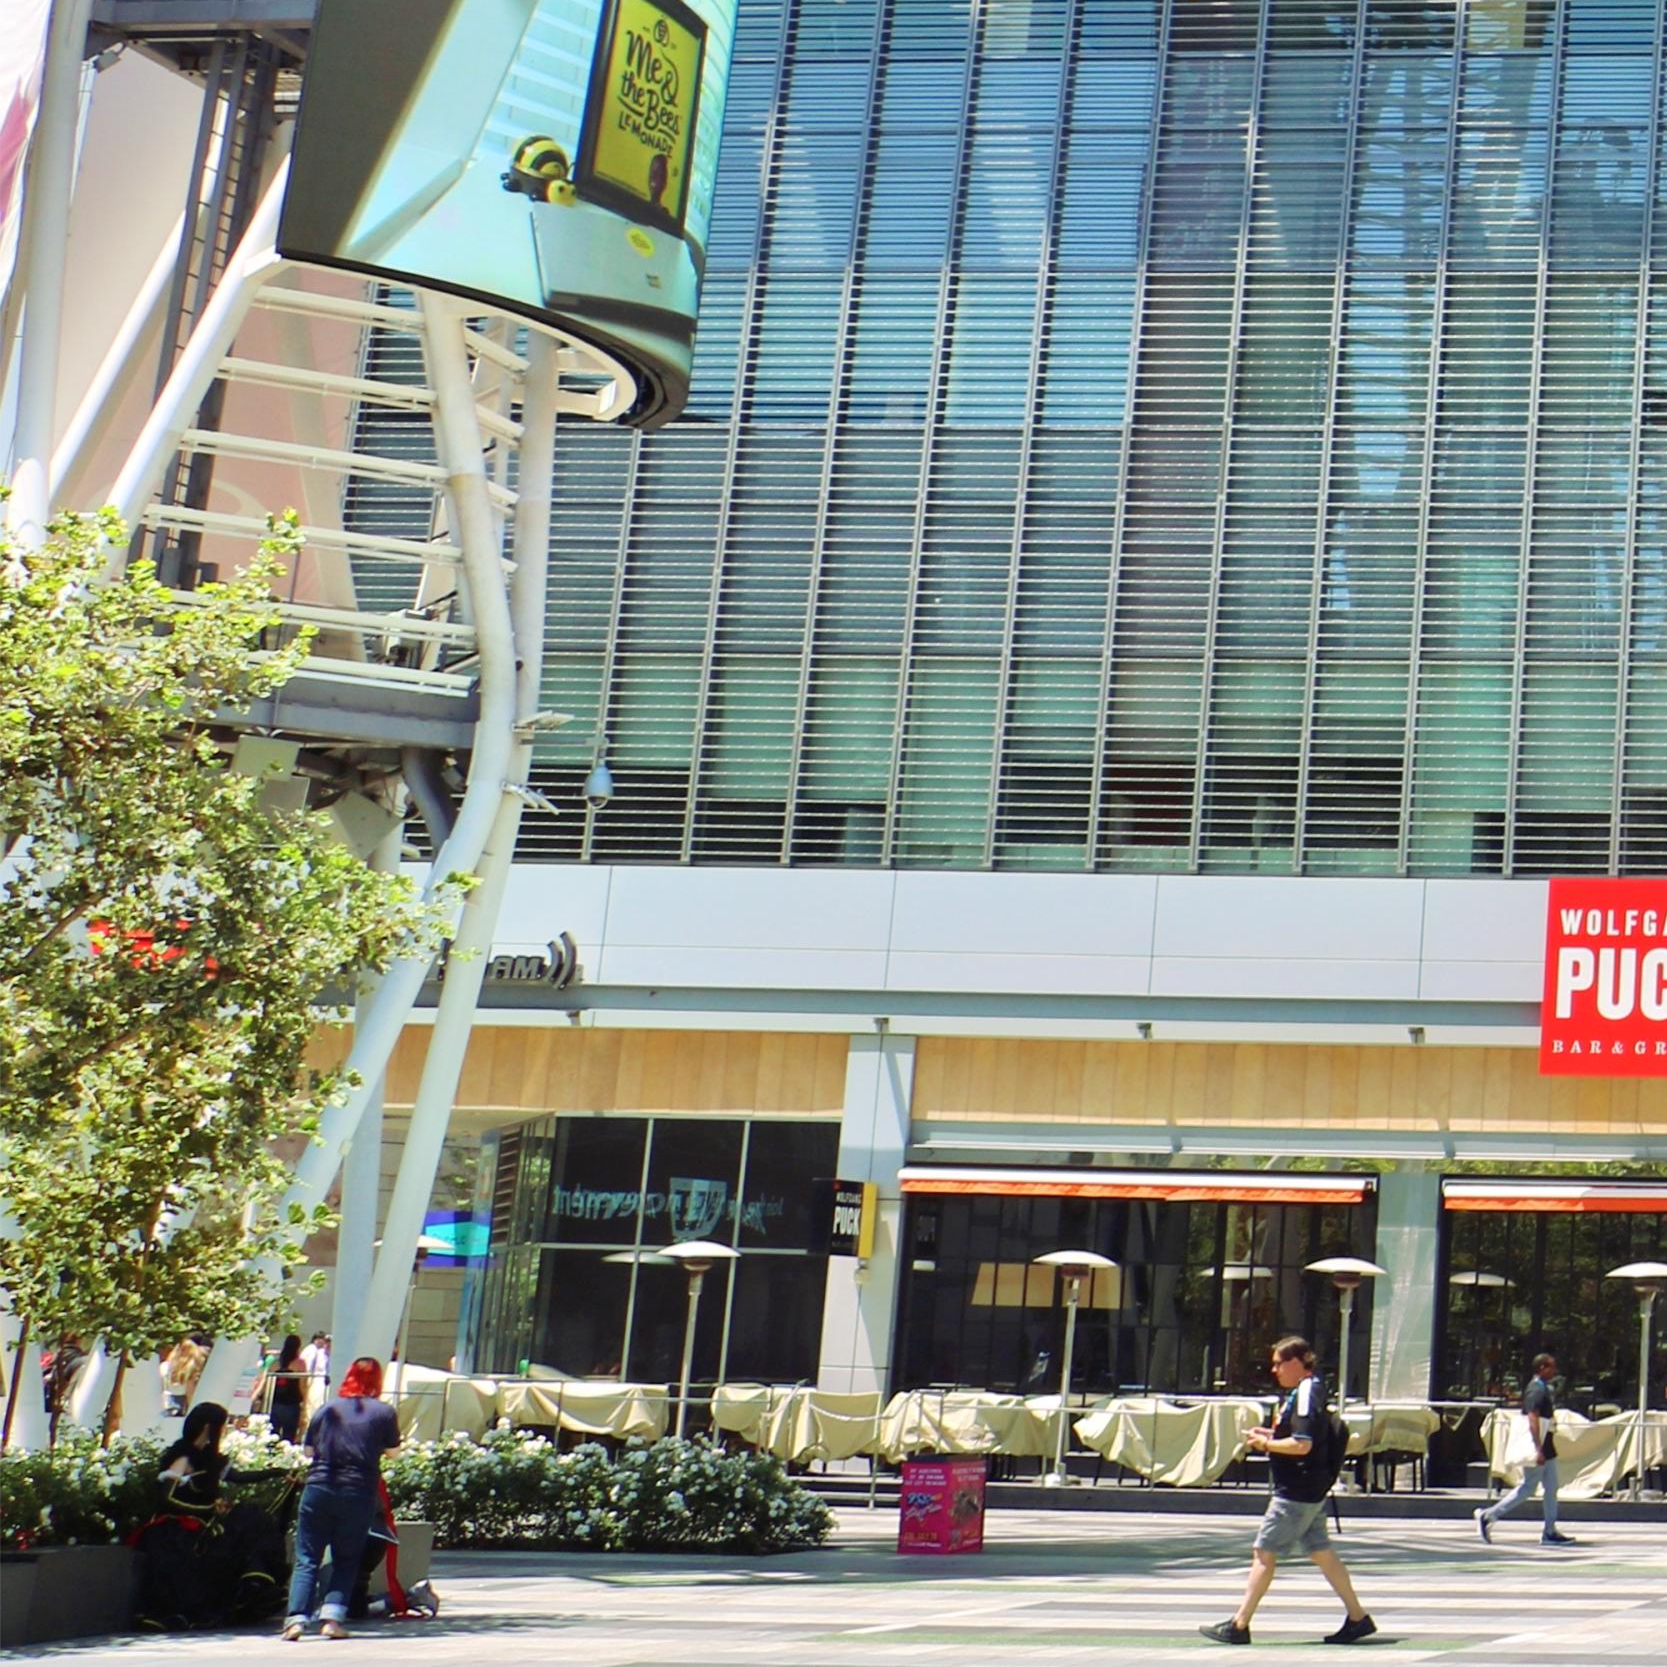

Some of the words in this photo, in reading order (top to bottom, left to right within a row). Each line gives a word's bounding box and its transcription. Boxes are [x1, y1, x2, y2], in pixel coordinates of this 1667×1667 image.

[626, 29, 664, 85] Me
[621, 70, 646, 108] the
[644, 88, 681, 135] Bees
[618, 111, 673, 160] LEMONADE
[1552, 1039, 1602, 1053] BAR
[1611, 1041, 1624, 1054] &
[832, 1206, 862, 1235] PUCK
